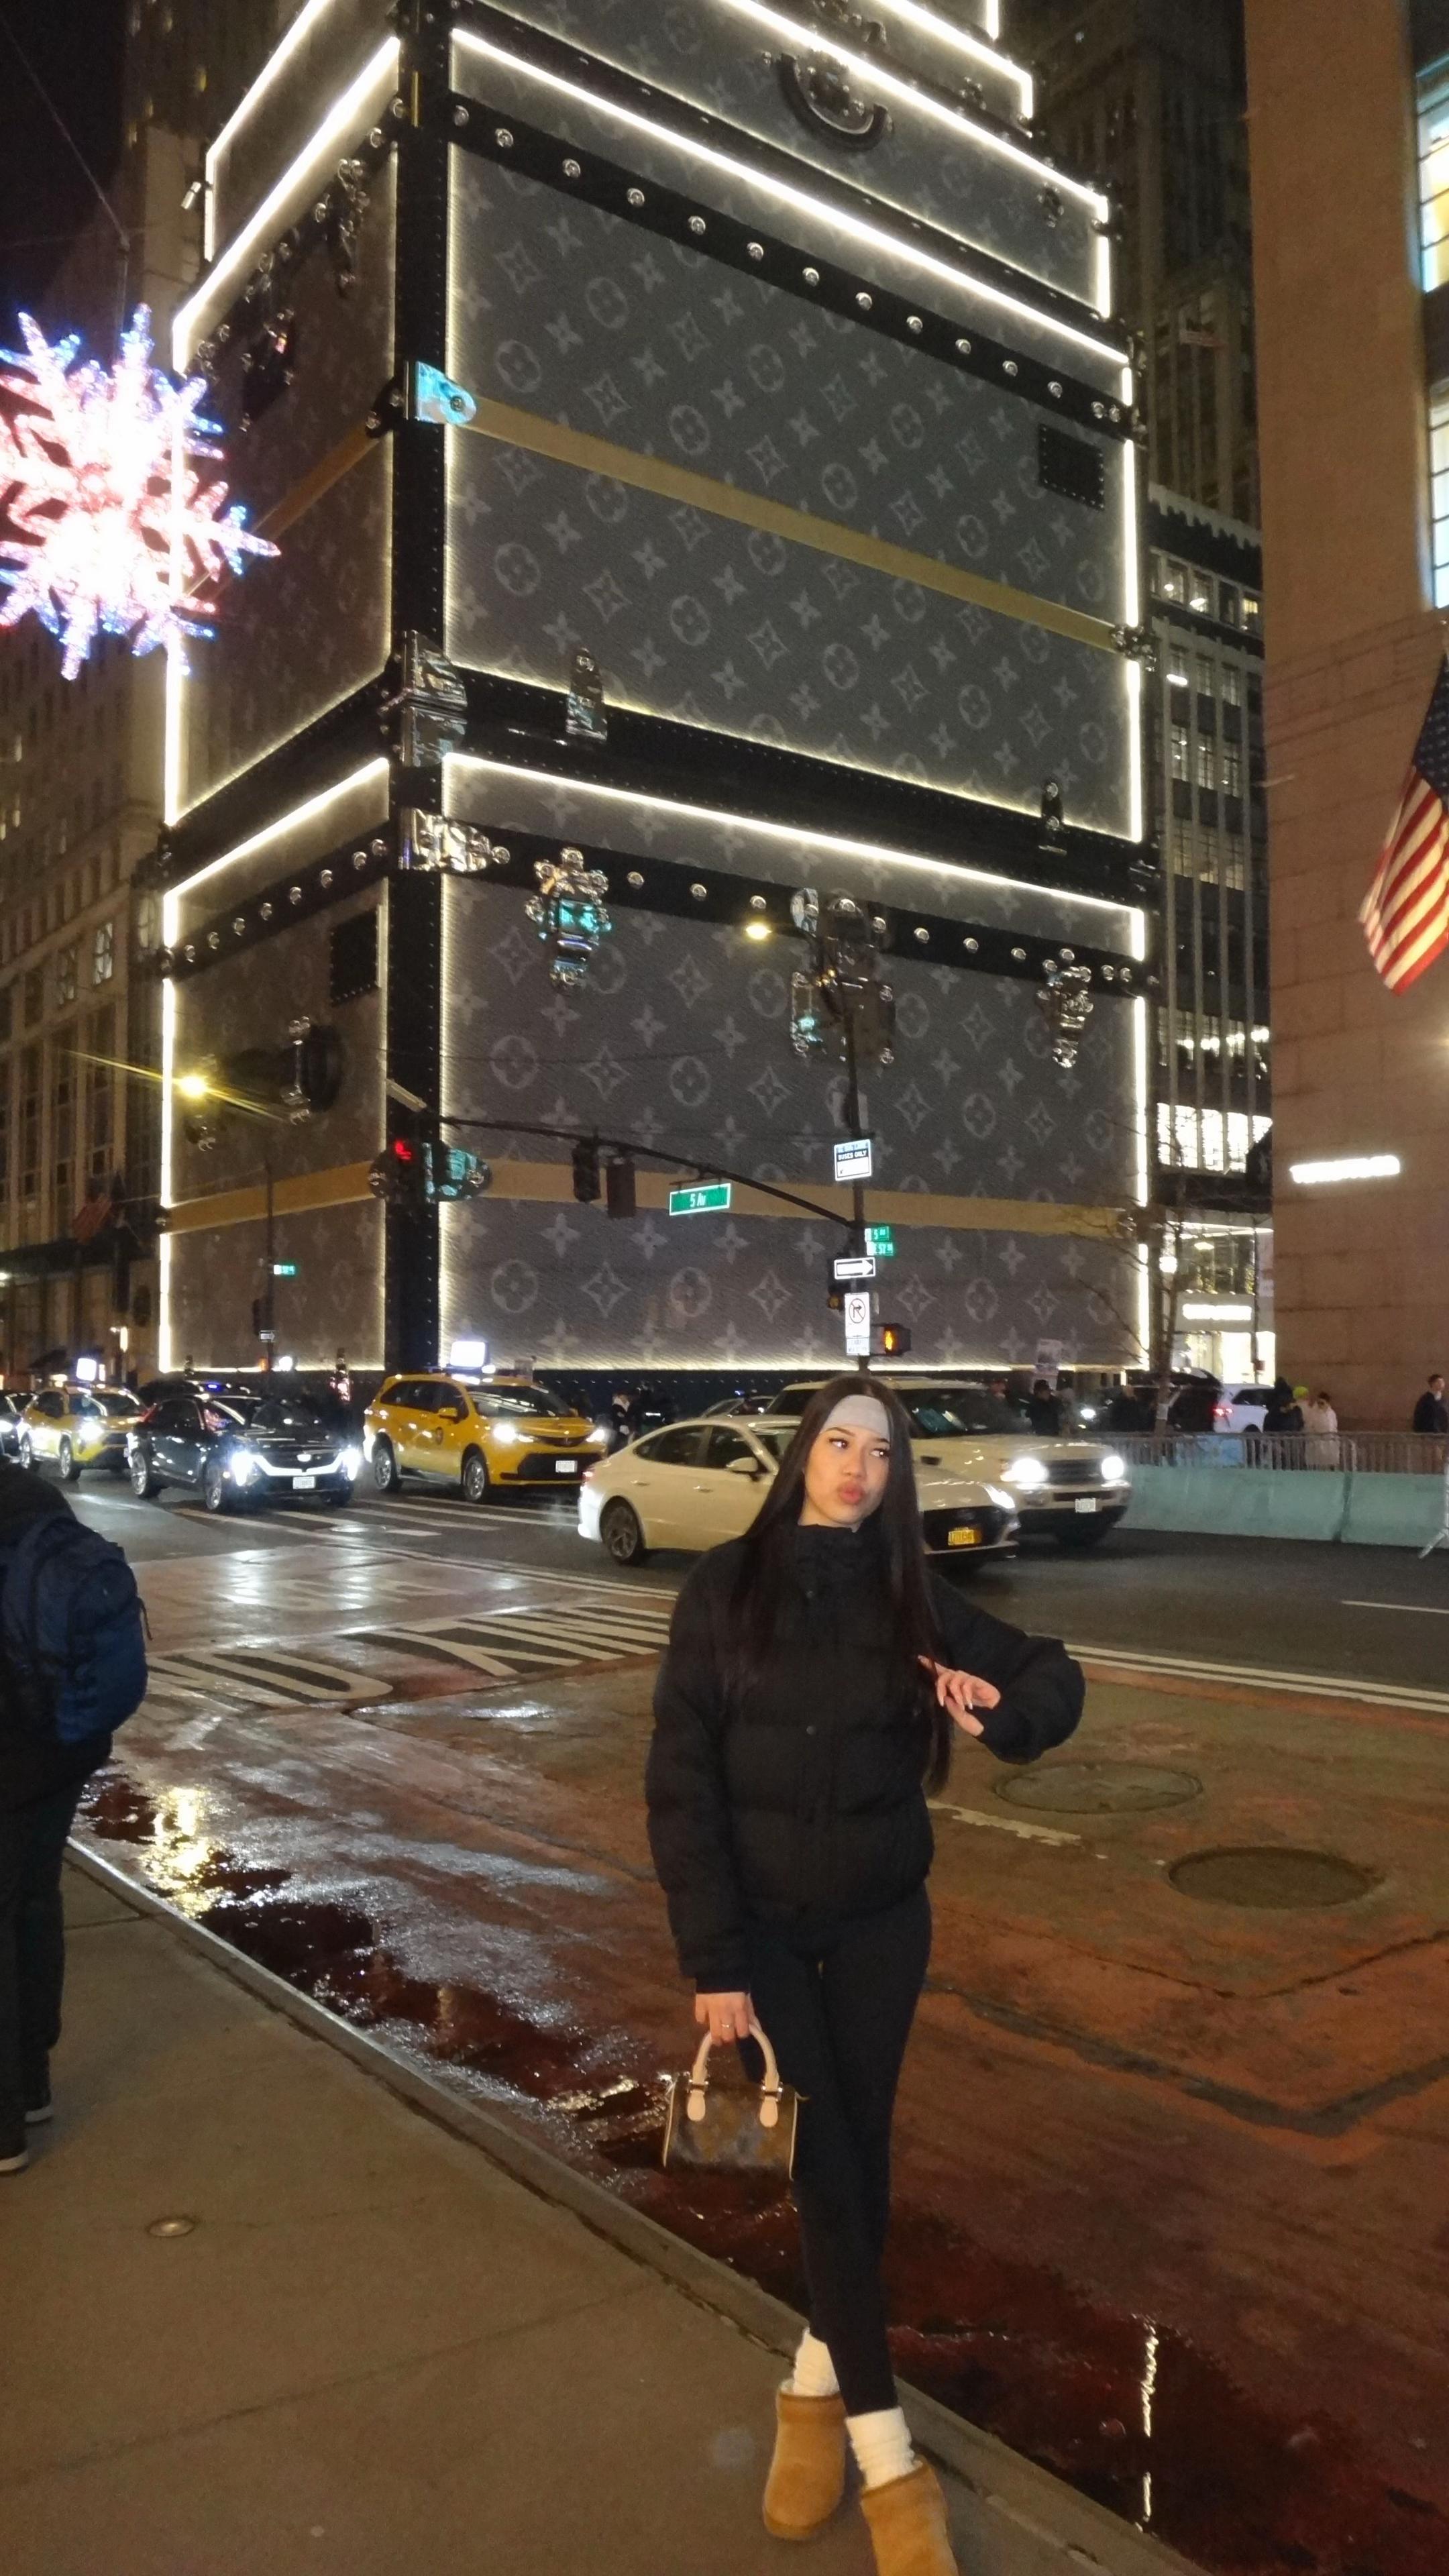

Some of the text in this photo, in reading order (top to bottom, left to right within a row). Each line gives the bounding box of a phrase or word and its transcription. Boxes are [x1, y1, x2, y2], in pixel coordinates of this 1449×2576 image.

[838, 1150, 867, 1161] BUSES ONLY
[690, 1193, 696, 1208] 5
